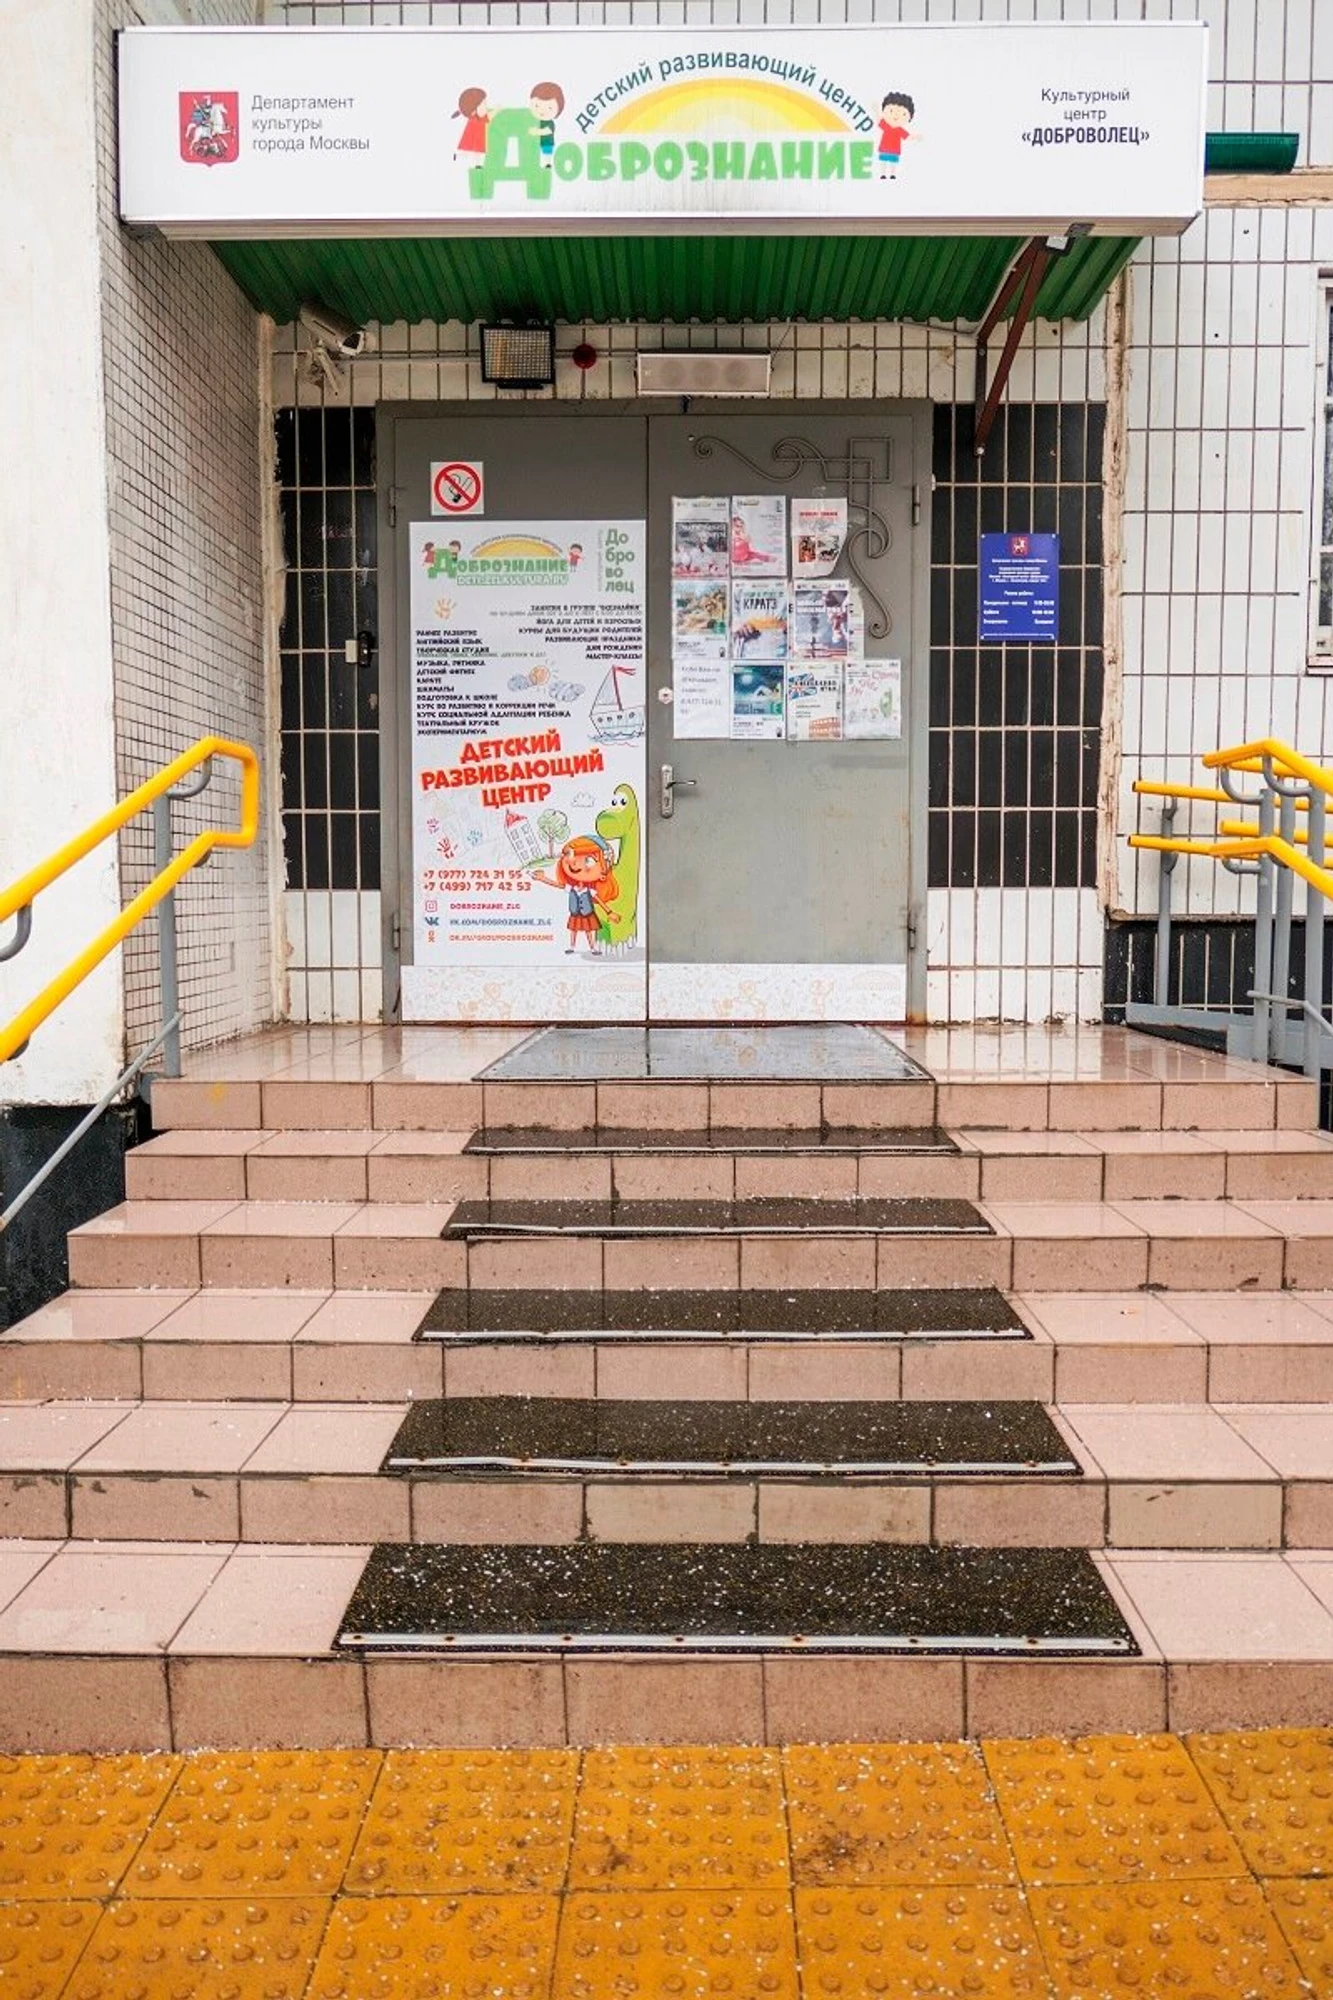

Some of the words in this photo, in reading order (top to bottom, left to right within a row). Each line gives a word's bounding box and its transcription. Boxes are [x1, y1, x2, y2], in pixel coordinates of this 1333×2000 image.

[576, 66, 652, 134] детский
[659, 52, 816, 87] развивающий
[819, 79, 874, 132] центр
[1042, 89, 1129, 104] Культурный
[251, 95, 354, 112] Департамент
[1064, 110, 1106, 122] центр
[252, 118, 322, 133] культуры
[253, 139, 304, 153] города
[310, 136, 369, 150] Москвы
[1022, 127, 1149, 146] «ДОБРОВОЛЕЦ»
[605, 528, 629, 546] До
[605, 548, 635, 565] бро
[605, 567, 624, 578] во
[459, 729, 561, 765] ДЕТСКИЙ
[421, 748, 604, 790] РАЗВИВАЮЩИЙ
[481, 783, 552, 809] ЦЕНТР
[424, 870, 434, 879] +7
[438, 870, 466, 879] (977)
[470, 870, 489, 879] 724
[494, 870, 504, 879] 31
[424, 882, 435, 891] +7
[440, 882, 471, 891] (499)
[475, 882, 494, 891] 717
[498, 882, 512, 891] 42
[517, 882, 531, 891] 53
